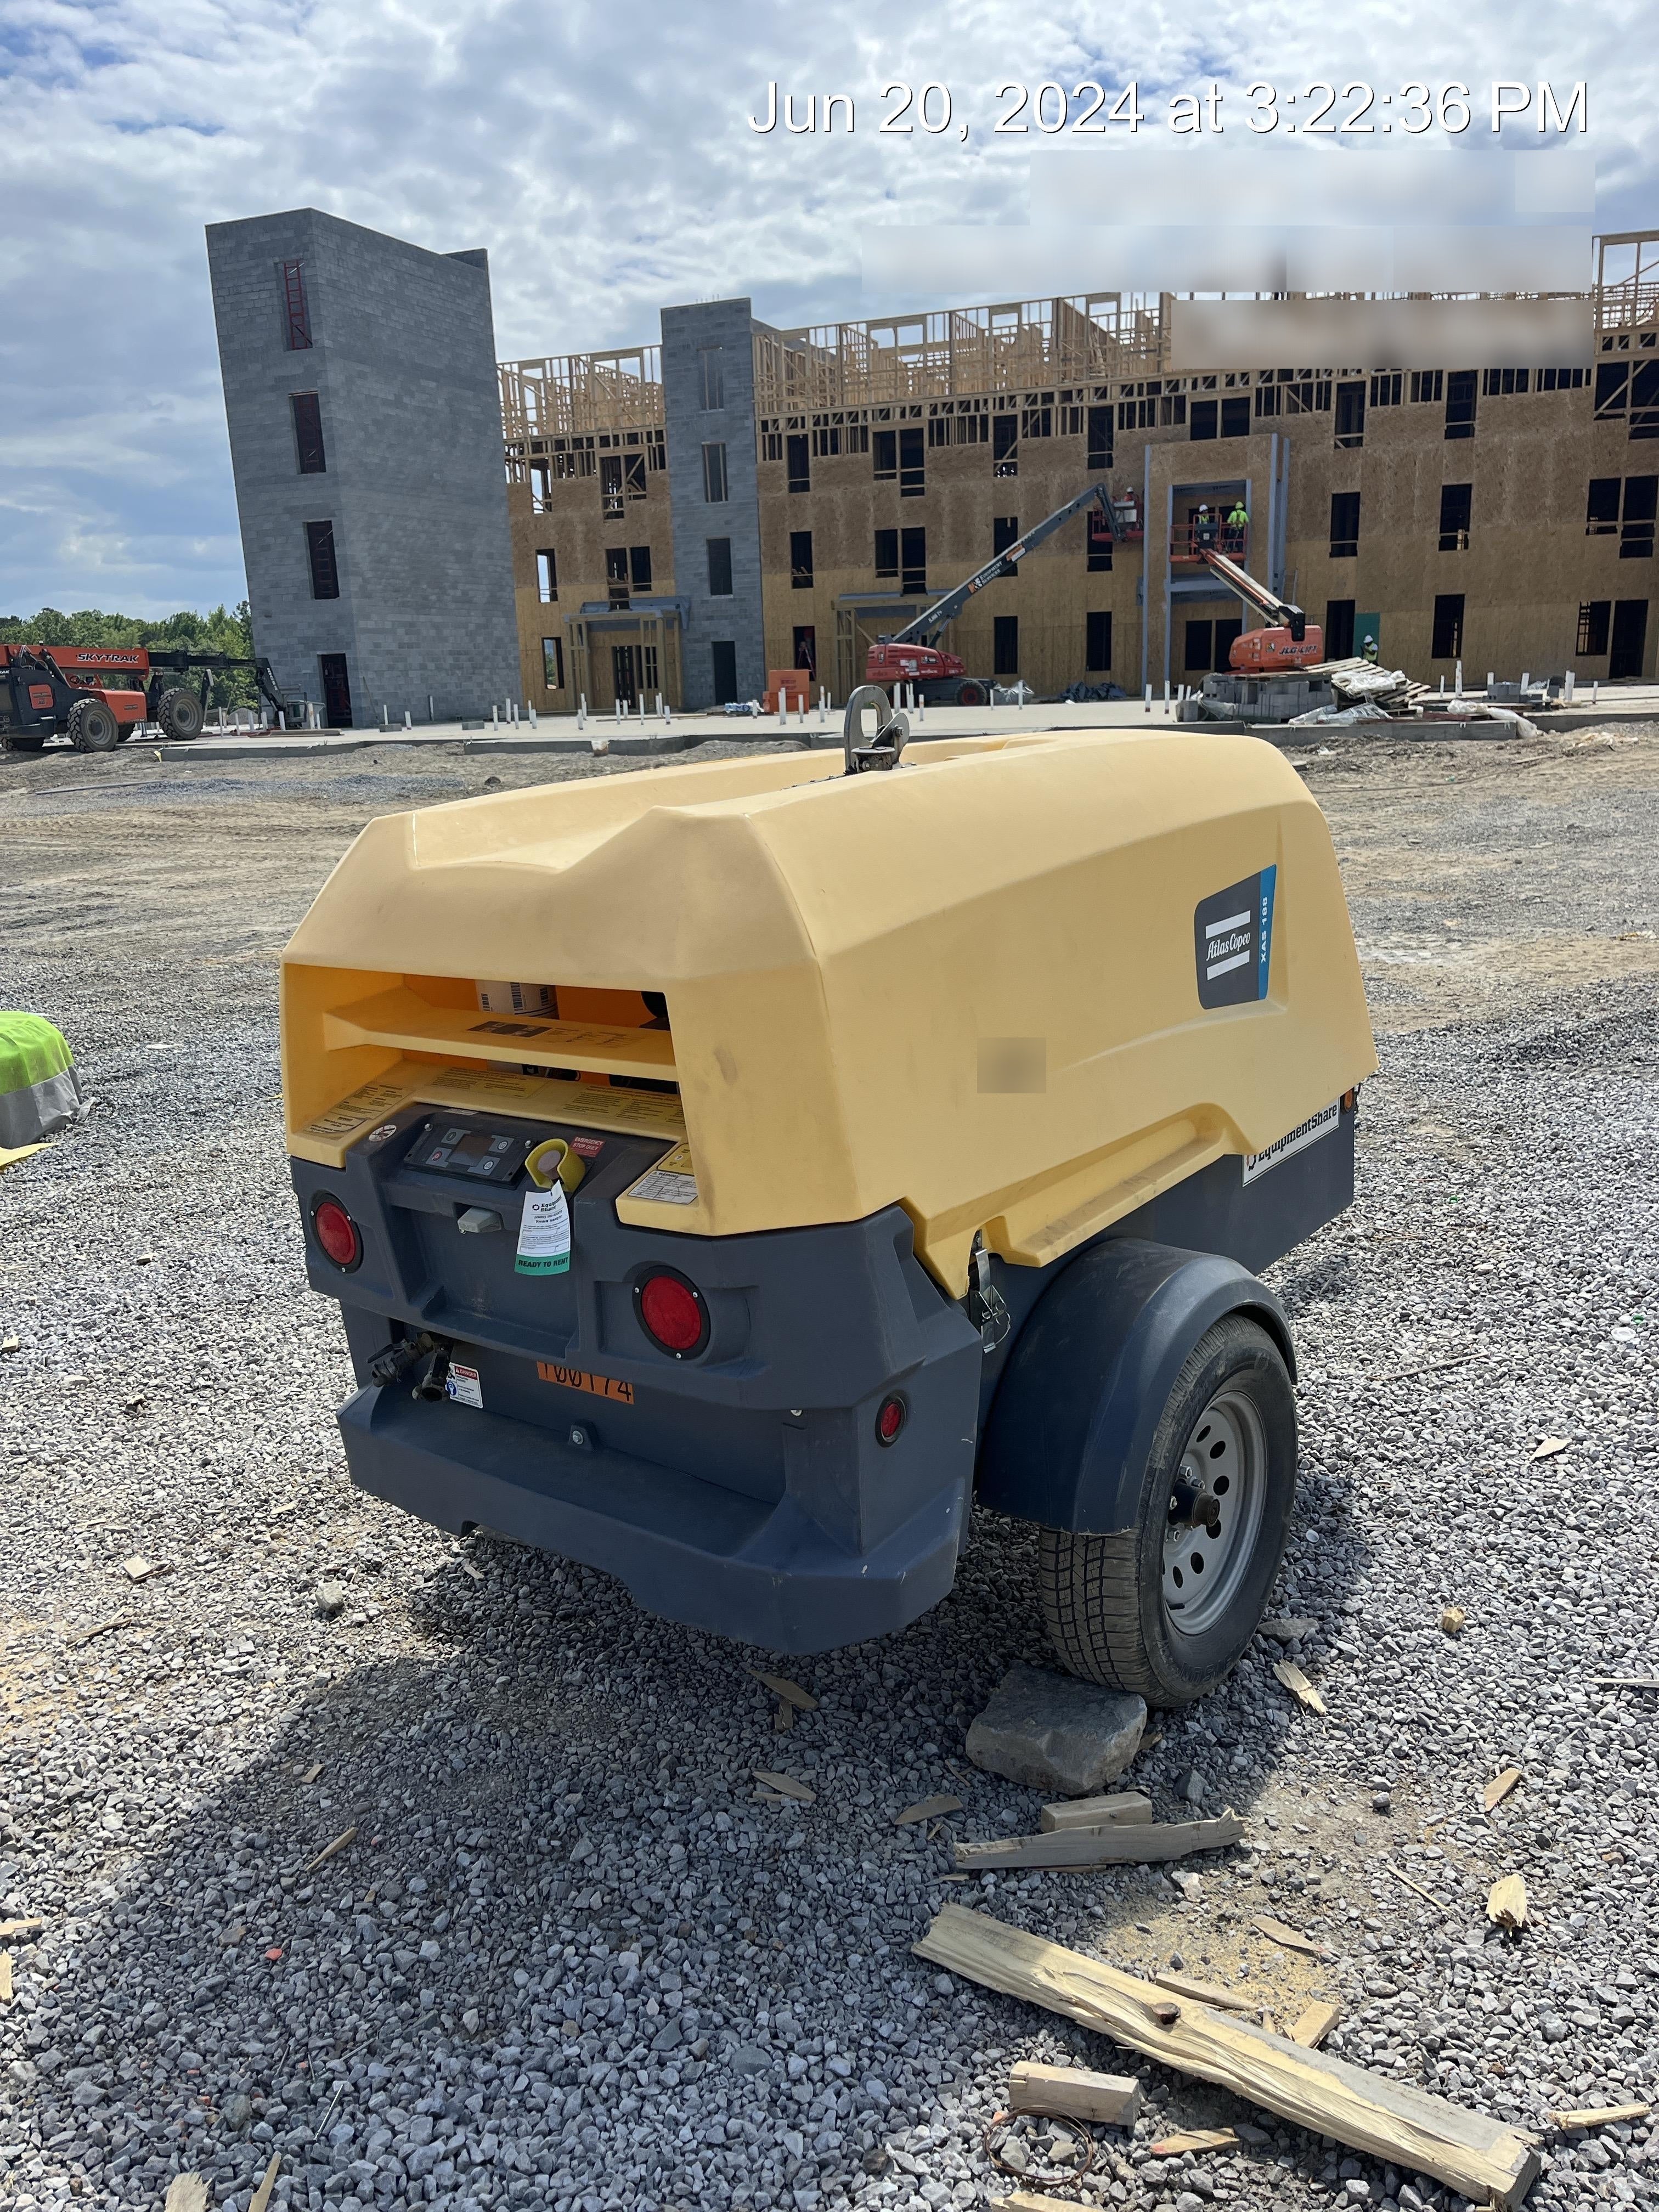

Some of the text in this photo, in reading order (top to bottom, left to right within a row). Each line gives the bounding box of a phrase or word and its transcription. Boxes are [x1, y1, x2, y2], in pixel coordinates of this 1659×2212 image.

[77, 653, 140, 663] SKYTRAK
[1206, 932, 1251, 961] Atlas Copco
[574, 1137, 604, 1146] EMERGENCY
[518, 1260, 541, 1268] READY
[553, 1256, 569, 1267] RENT
[459, 1369, 477, 1378] DANGER
